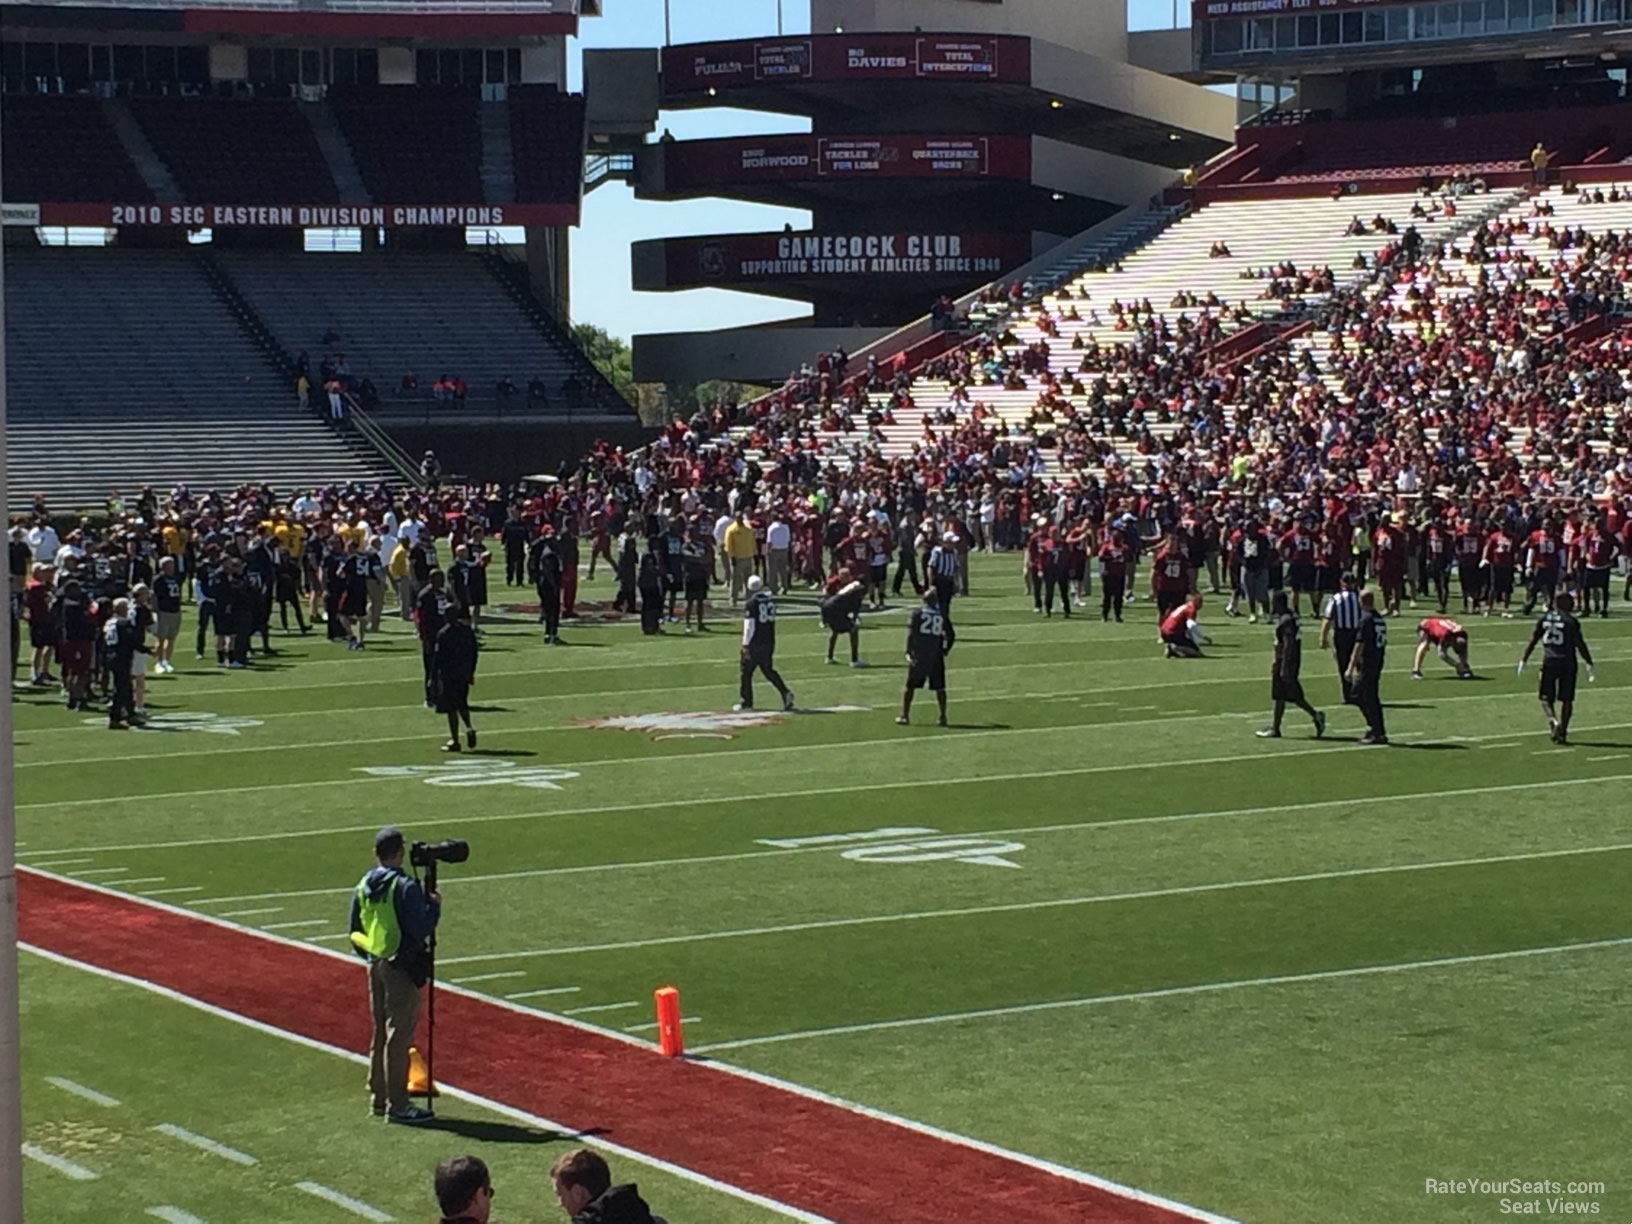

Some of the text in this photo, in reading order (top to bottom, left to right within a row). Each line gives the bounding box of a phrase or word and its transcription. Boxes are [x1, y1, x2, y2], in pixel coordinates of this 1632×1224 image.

[848, 57, 906, 68] DAVIES
[742, 155, 809, 169] NORWOOD
[112, 206, 504, 225] 2010 SEC EASTERN DIVISION CHAMPIONS
[778, 235, 961, 258] GAMECOCK CLUB
[740, 259, 808, 275] SUPPORTING
[812, 258, 867, 274] STUDENT
[871, 258, 931, 273] ATHLETES
[935, 257, 970, 273] SINCE
[757, 603, 776, 624] 83
[919, 613, 944, 635] 28
[1542, 621, 1565, 645] 25
